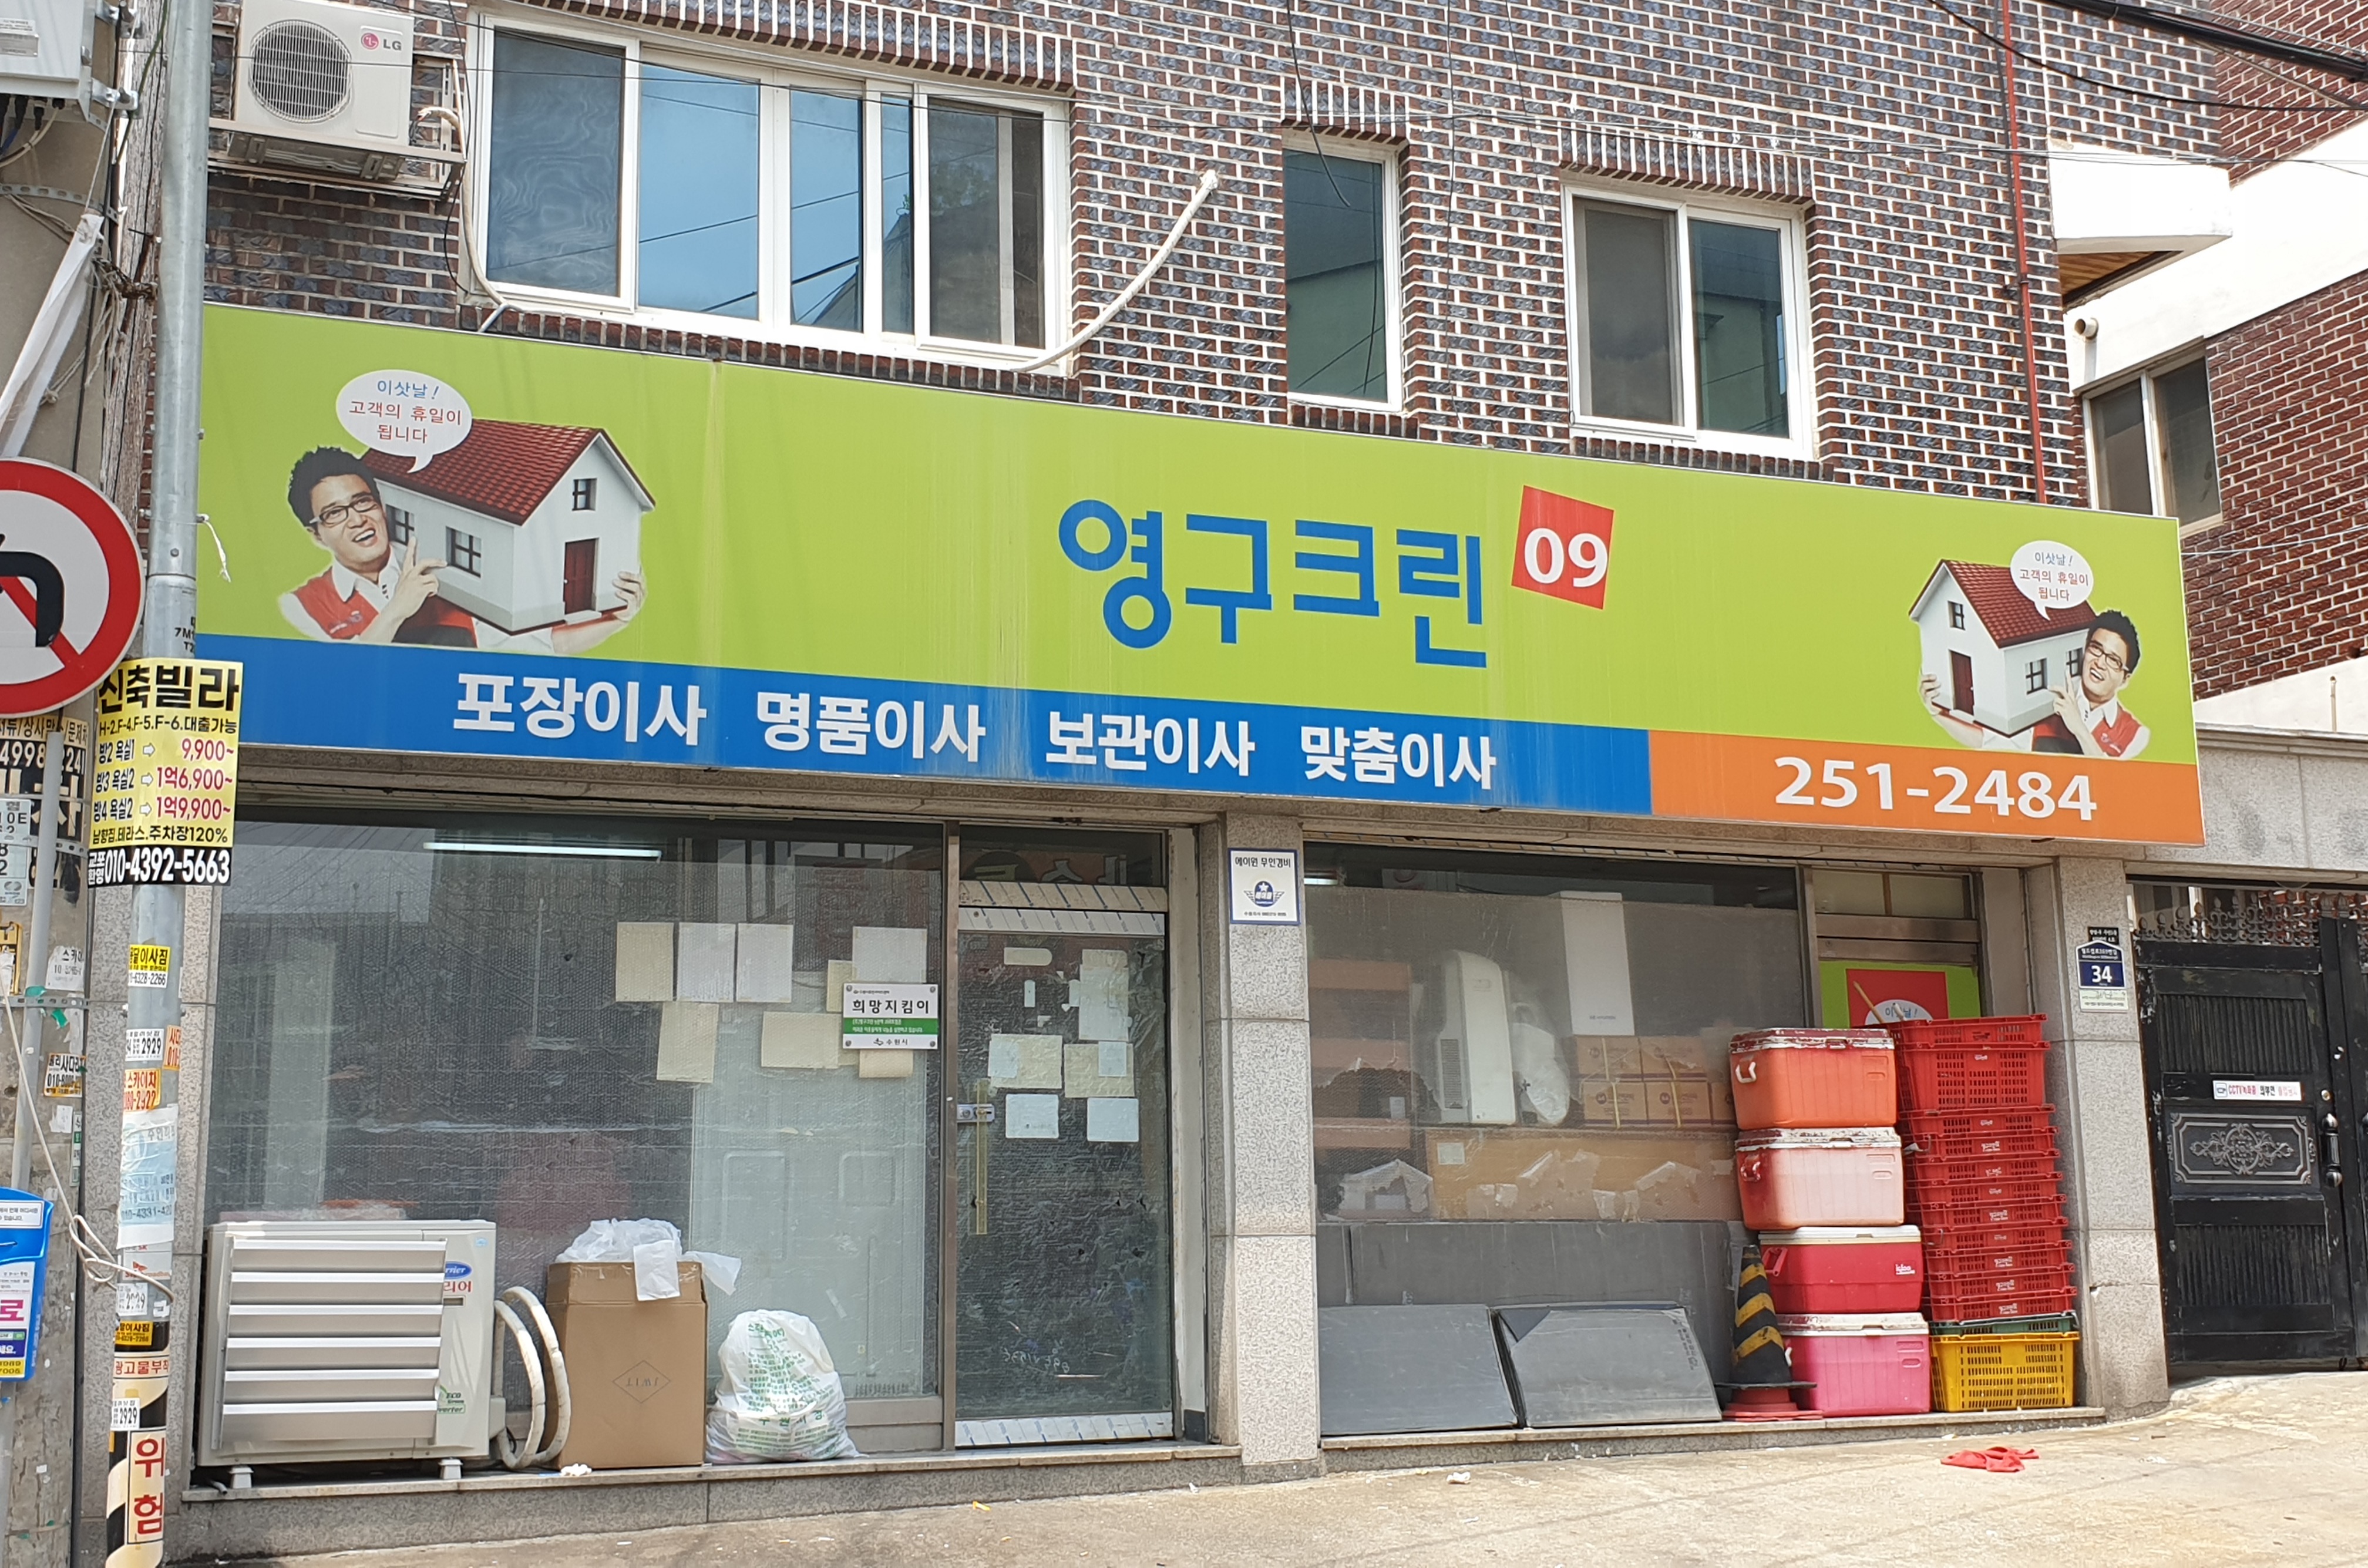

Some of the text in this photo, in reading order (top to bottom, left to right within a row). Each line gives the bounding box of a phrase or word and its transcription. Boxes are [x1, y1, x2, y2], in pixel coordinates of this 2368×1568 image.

[383, 39, 402, 51] LG
[348, 401, 462, 426] 고객의 휴일이
[377, 425, 428, 444] 됩니다
[1523, 526, 1609, 588] 09
[1058, 499, 1488, 669] 영구크린
[2020, 568, 2089, 586] 고객의 휴일이
[2038, 587, 2070, 601] 됩니다
[99, 664, 240, 715] 신축빌라
[453, 673, 1496, 789] 포장이사 명품이사 보관이사 맞춤이사
[99, 741, 113, 764] 방2
[96, 770, 110, 793] 방3
[112, 768, 134, 791] 욕실2
[1774, 756, 2097, 821] 251-2484
[94, 800, 107, 822] 방4
[110, 797, 133, 821] 욕실2
[105, 847, 231, 884] 010-4392-5663
[2091, 965, 2113, 983] 34
[852, 999, 929, 1014] 희망지킴이
[445, 1266, 466, 1274] rrier
[443, 1281, 472, 1293] 리어
[134, 1436, 166, 1536] 위험
